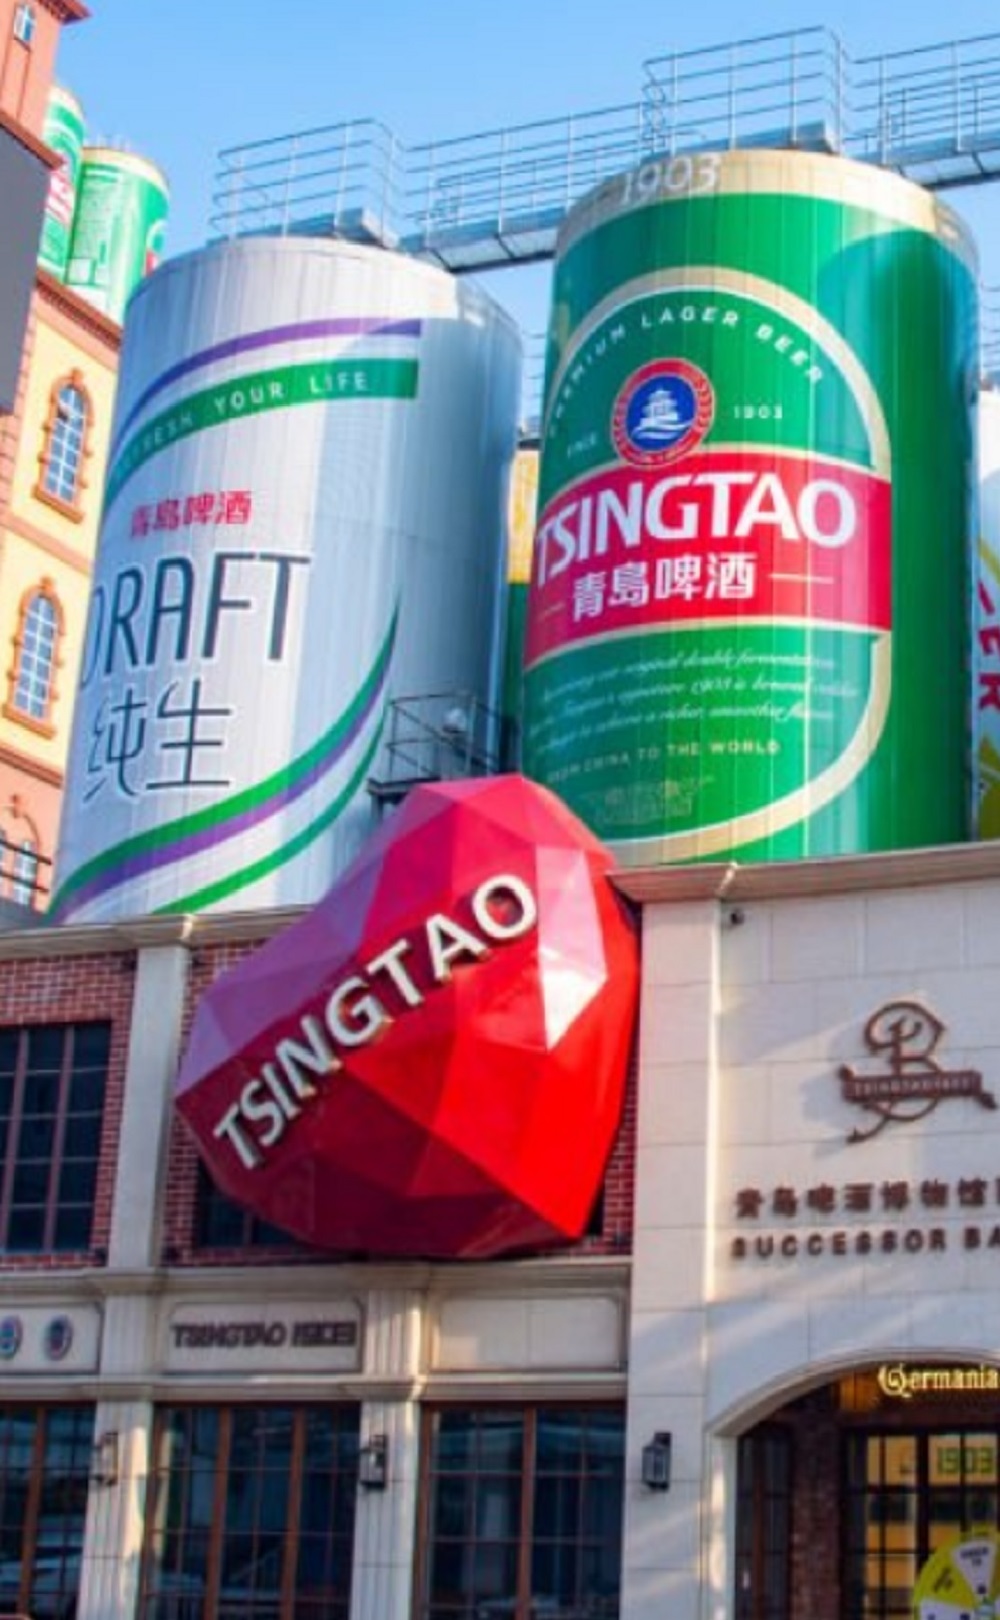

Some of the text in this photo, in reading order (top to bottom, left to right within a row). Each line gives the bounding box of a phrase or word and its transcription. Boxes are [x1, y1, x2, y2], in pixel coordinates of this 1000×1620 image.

[213, 379, 285, 416] YOUR
[309, 371, 368, 395] LIFE
[641, 305, 738, 329] LAGER
[754, 322, 823, 384] BEER
[536, 471, 857, 590] TSINGTAO
[83, 677, 232, 804] 纯生
[212, 873, 537, 1170] TSINGTAO
[730, 1227, 946, 1260] SUCCESSOR
